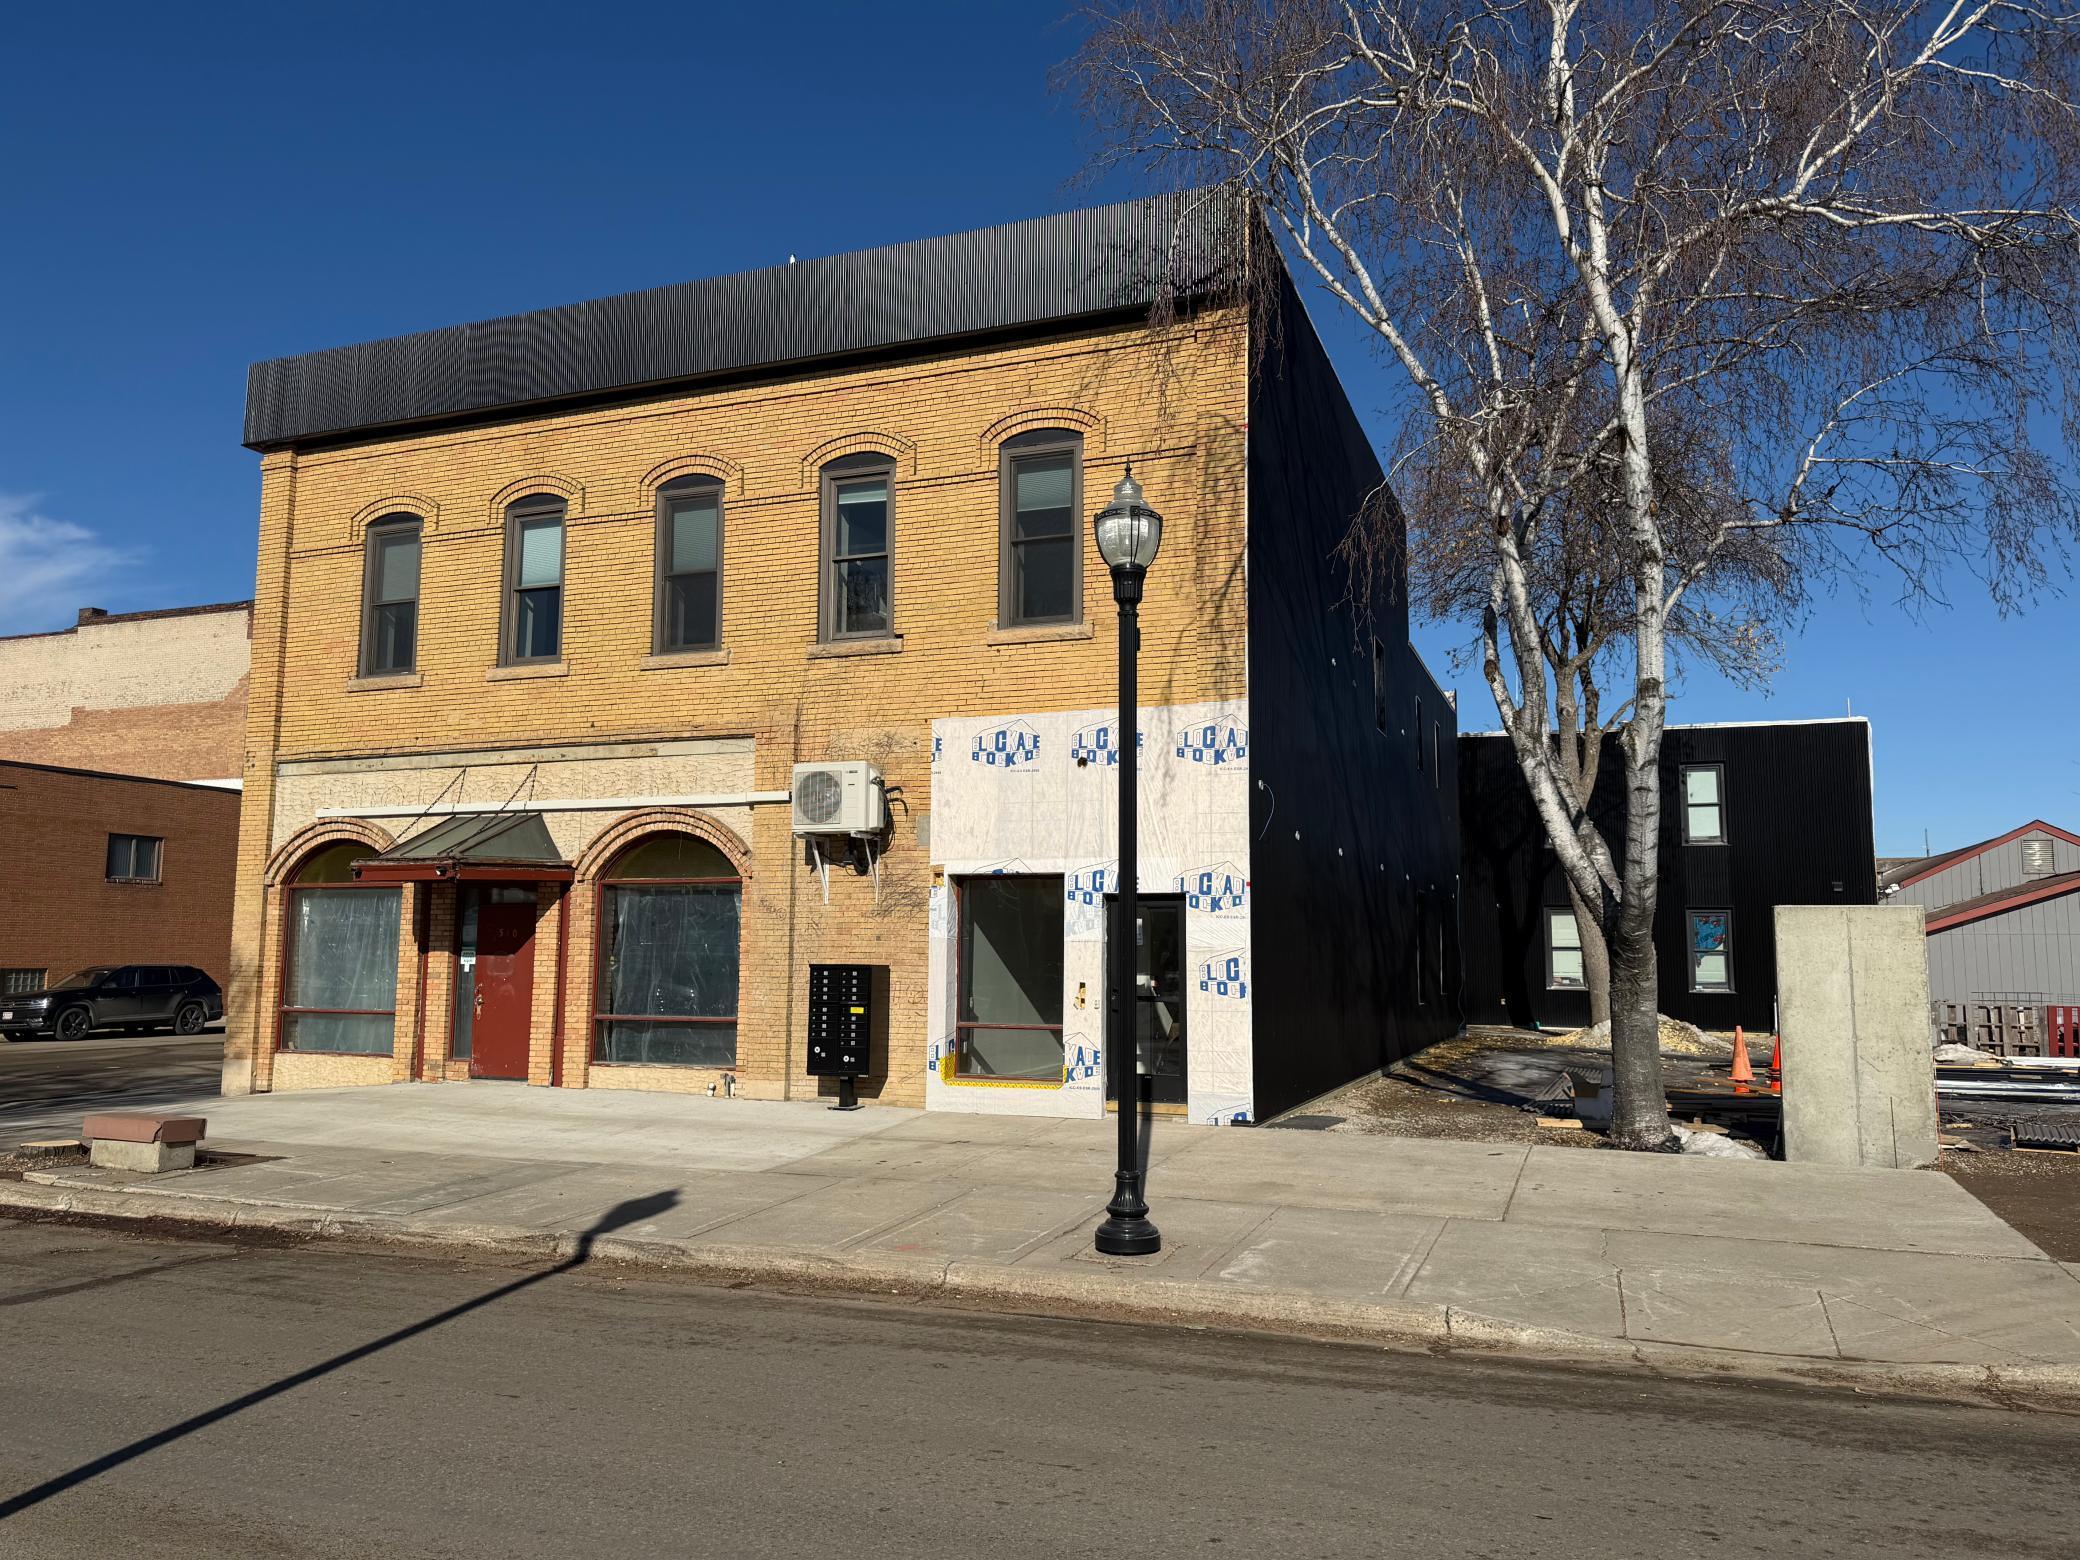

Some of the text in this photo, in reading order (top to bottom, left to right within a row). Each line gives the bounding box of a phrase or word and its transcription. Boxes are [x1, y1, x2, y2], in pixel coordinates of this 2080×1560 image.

[972, 730, 1040, 752] BLOCKADE
[1072, 727, 1143, 749] BLOCKE
[1199, 958, 1246, 981] BLOC
[1065, 1043, 1100, 1067] KADE
